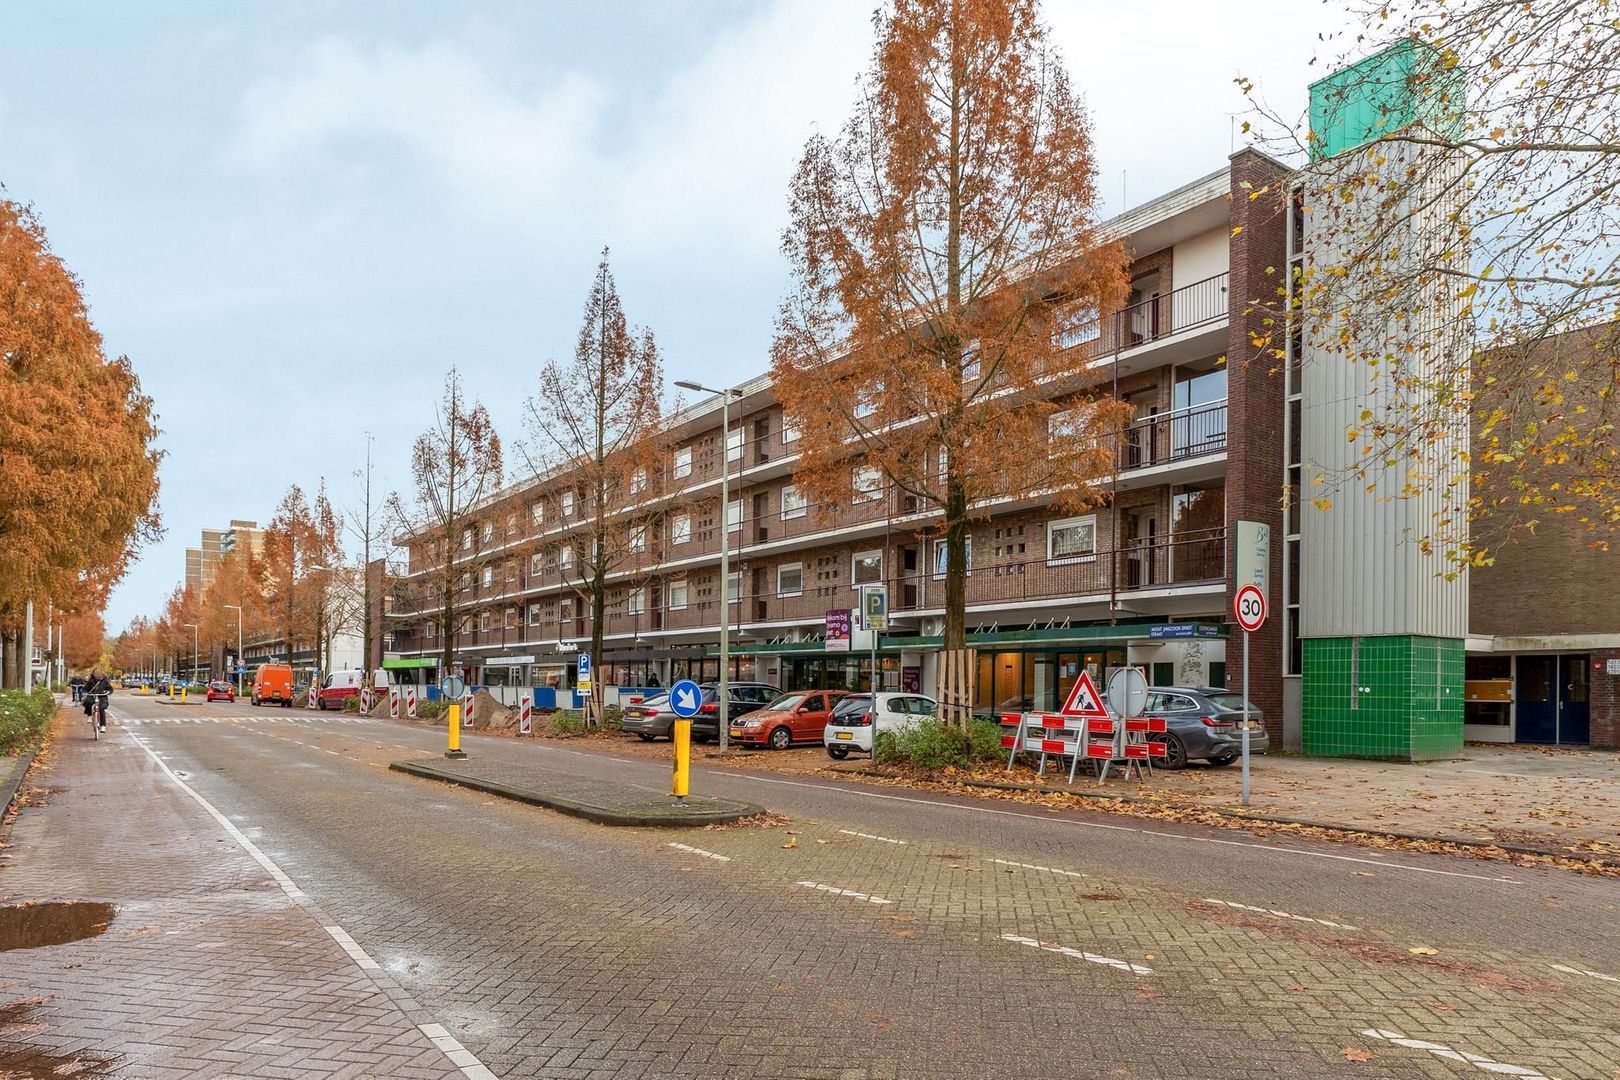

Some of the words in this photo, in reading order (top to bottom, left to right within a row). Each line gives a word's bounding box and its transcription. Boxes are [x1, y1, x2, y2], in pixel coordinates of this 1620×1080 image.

[871, 595, 881, 613] P
[1241, 599, 1261, 617] 30
[580, 656, 588, 667] P
